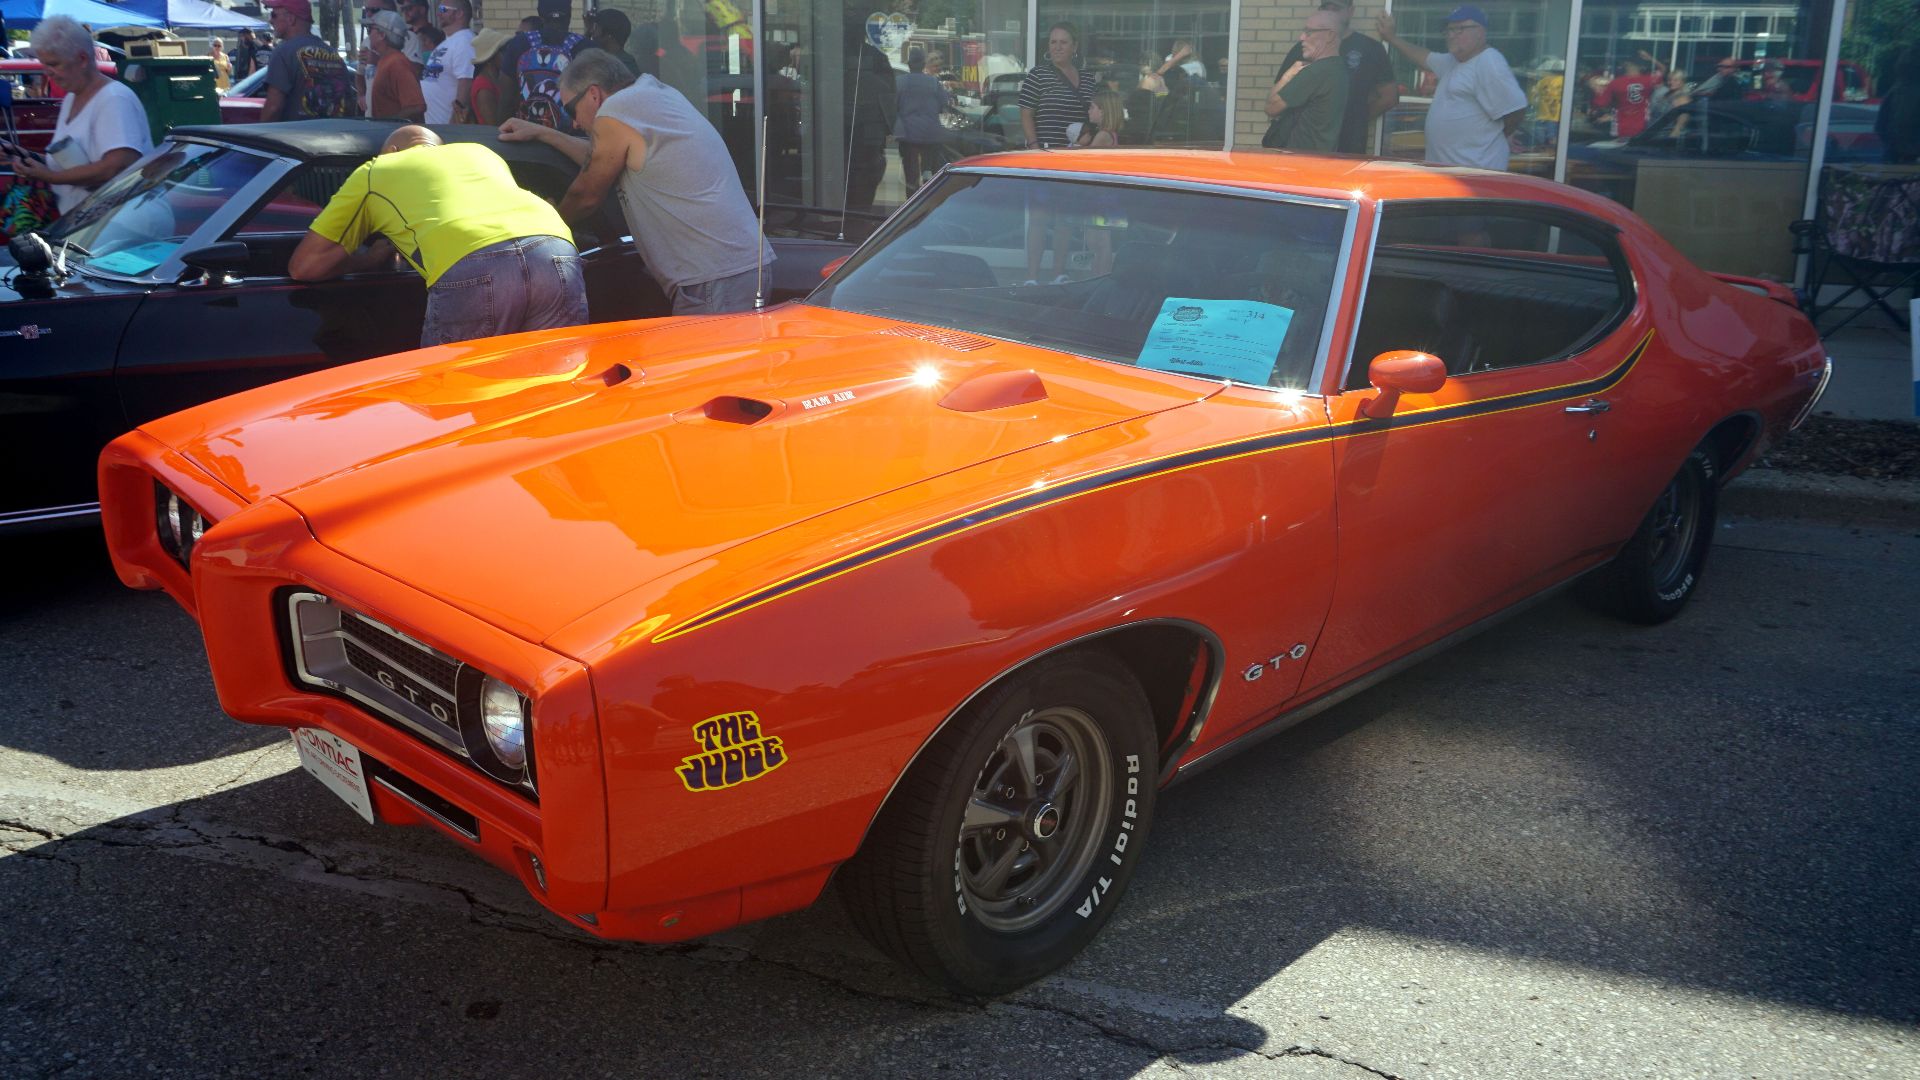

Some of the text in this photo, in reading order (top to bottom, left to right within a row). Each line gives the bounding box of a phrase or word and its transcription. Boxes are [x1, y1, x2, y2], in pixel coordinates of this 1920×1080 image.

[802, 390, 856, 410] RAM AIR
[1243, 643, 1307, 682] GTO
[377, 670, 449, 722] GTO
[694, 712, 762, 752] THE
[677, 737, 786, 791] JUDGE
[1075, 754, 1140, 919] Radial T/A
